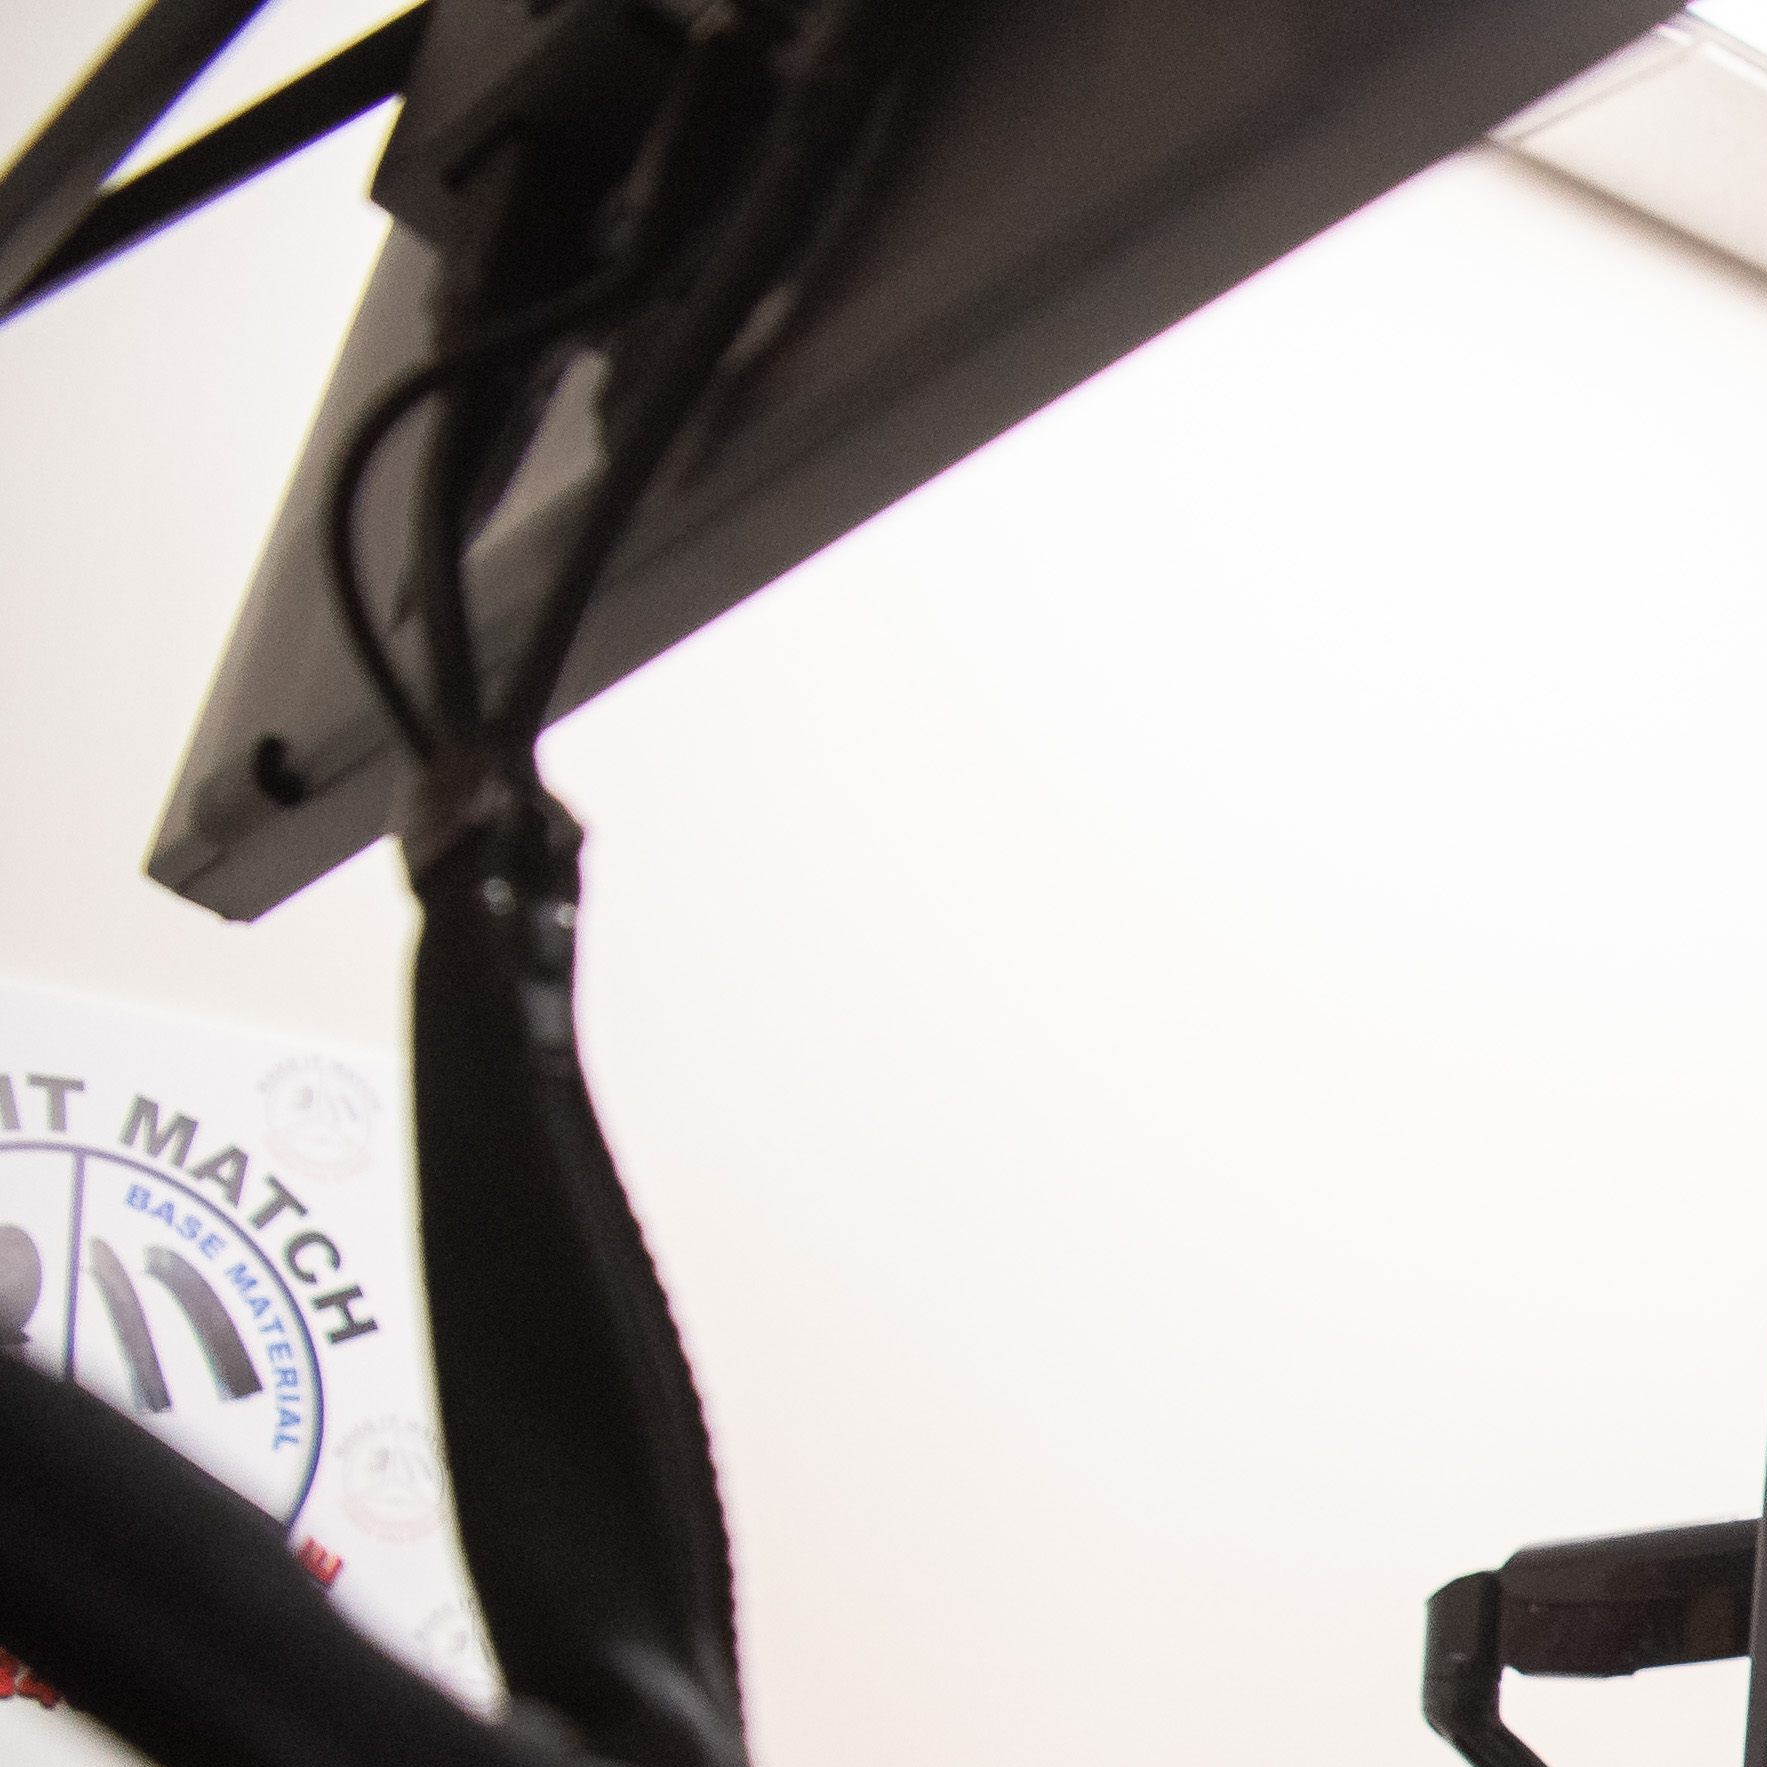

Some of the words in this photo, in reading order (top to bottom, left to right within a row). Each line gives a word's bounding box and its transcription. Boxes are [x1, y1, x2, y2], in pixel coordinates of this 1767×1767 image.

[118, 1093, 379, 1346] MATCH
[124, 1183, 228, 1261] BASE
[225, 1261, 302, 1452] MATERIAL
